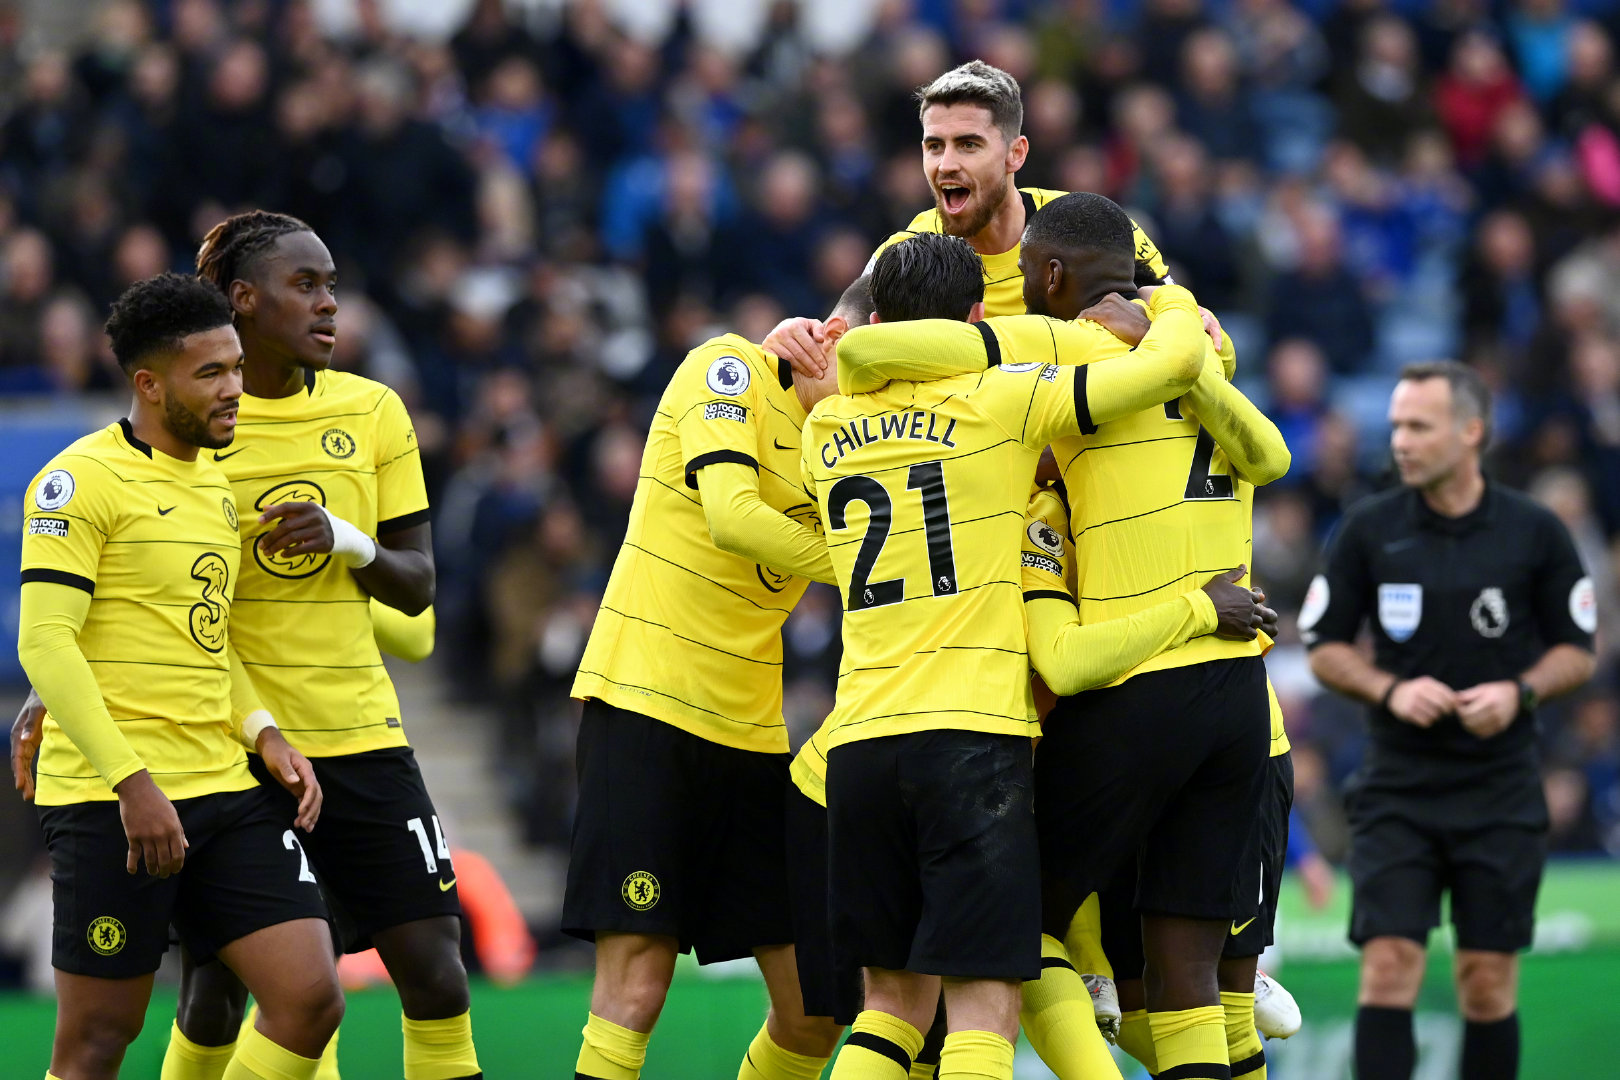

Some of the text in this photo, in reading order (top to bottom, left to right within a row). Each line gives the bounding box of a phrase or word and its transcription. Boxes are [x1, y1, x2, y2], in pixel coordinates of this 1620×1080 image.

[704, 403, 743, 416] No room
[703, 411, 747, 424] for racism
[821, 411, 957, 469] CHILWELL
[40, 519, 65, 529] room
[38, 527, 68, 537] racism
[828, 460, 958, 612] 21
[407, 815, 455, 873] 14
